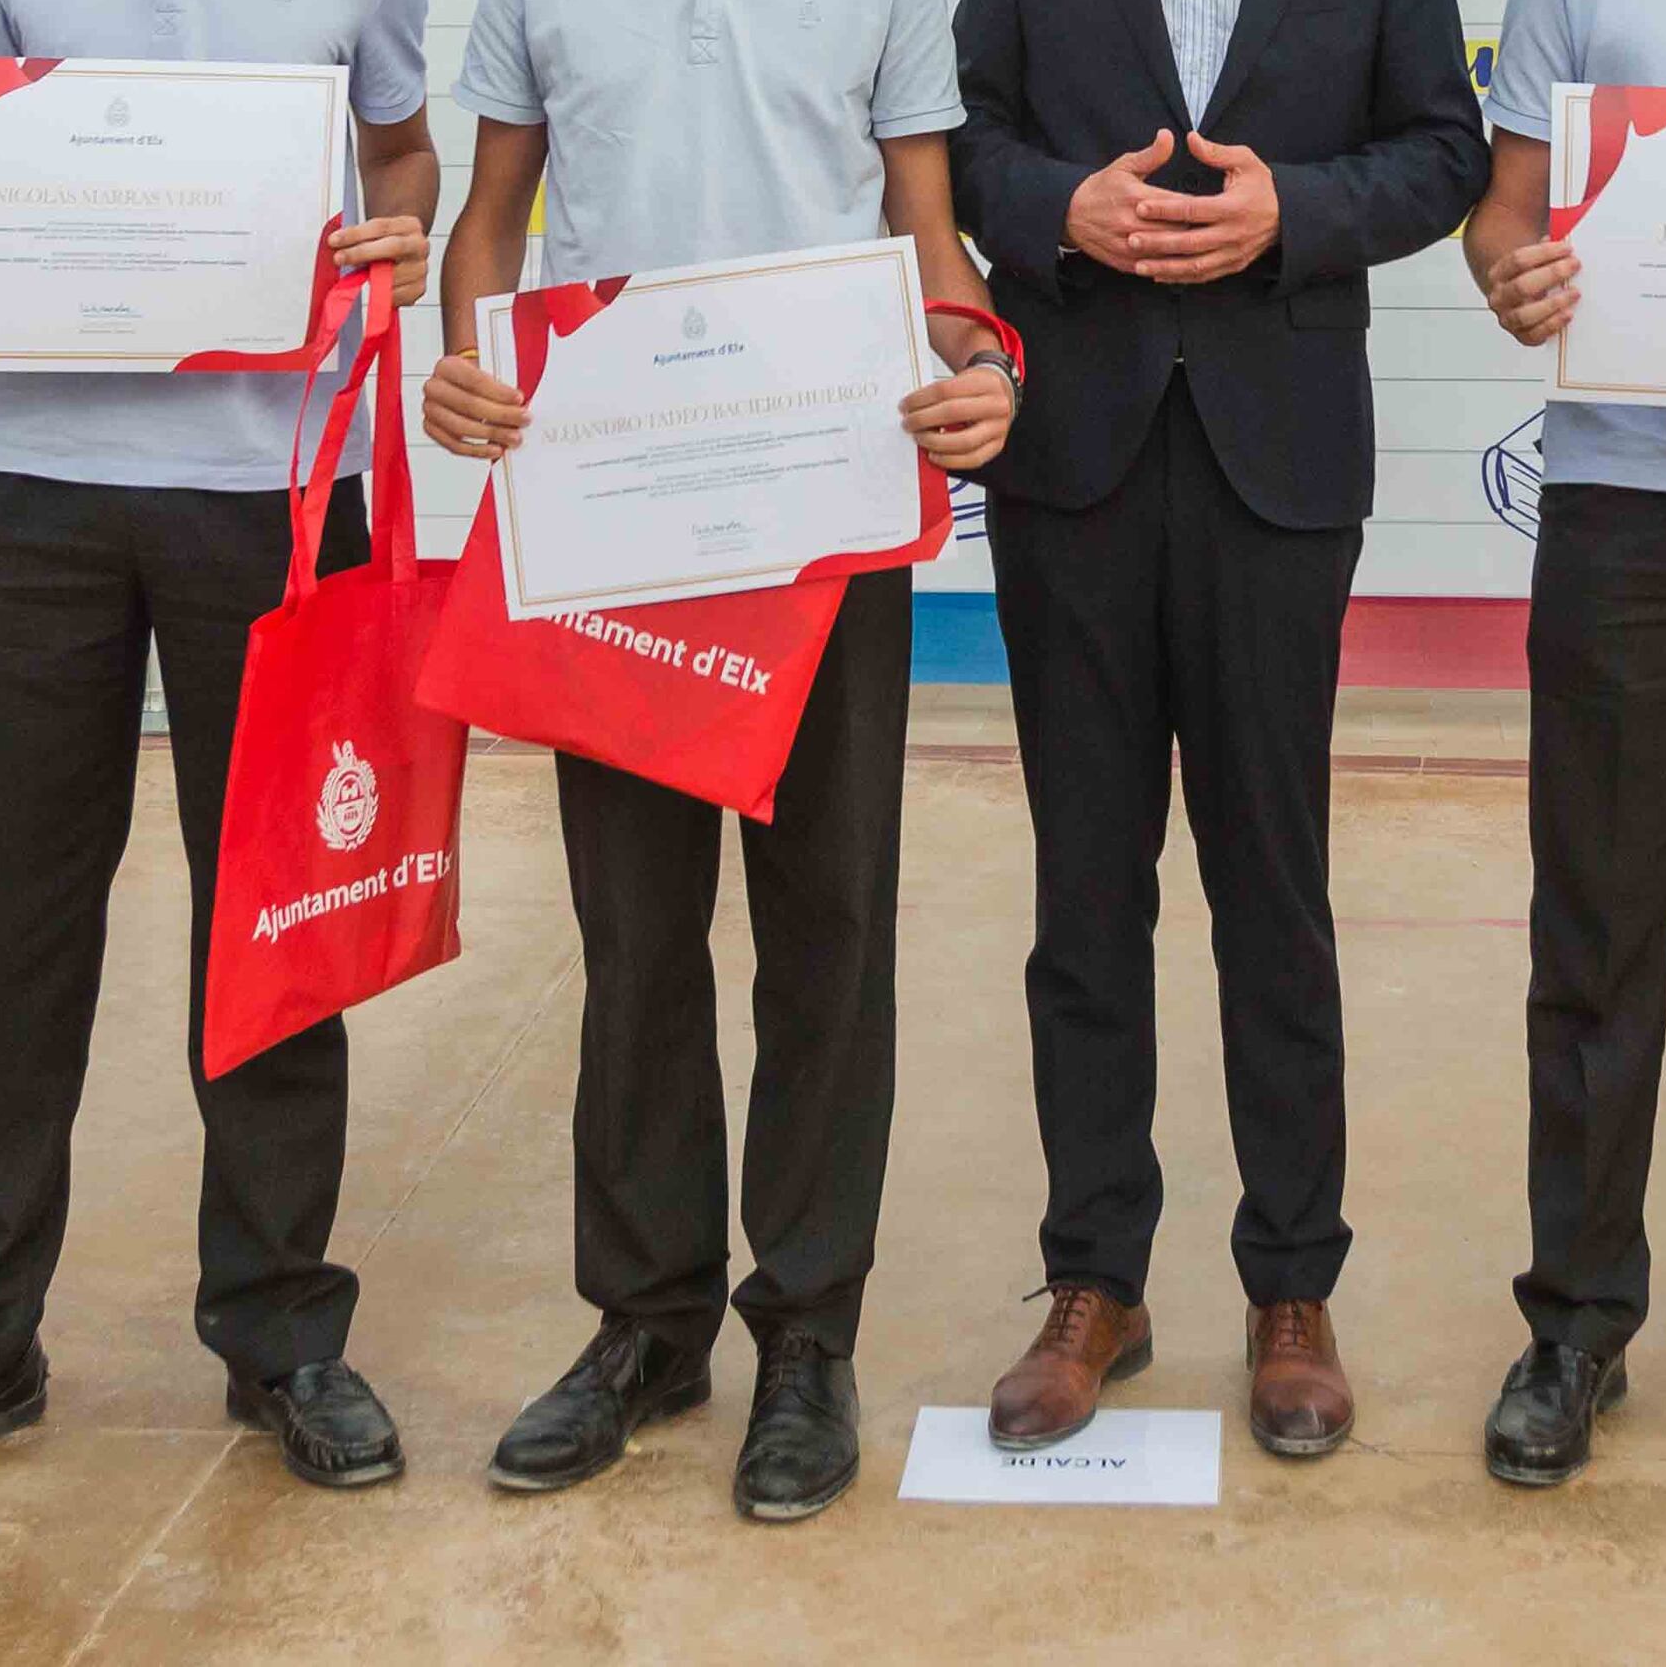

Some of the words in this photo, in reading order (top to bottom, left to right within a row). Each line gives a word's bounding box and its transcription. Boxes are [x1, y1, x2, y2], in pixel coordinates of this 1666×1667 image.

[547, 610, 688, 668] ntament
[691, 644, 773, 695] d'Elx
[252, 867, 389, 944] Ajuntament
[1002, 1457, 1126, 1469] ALCALDE
